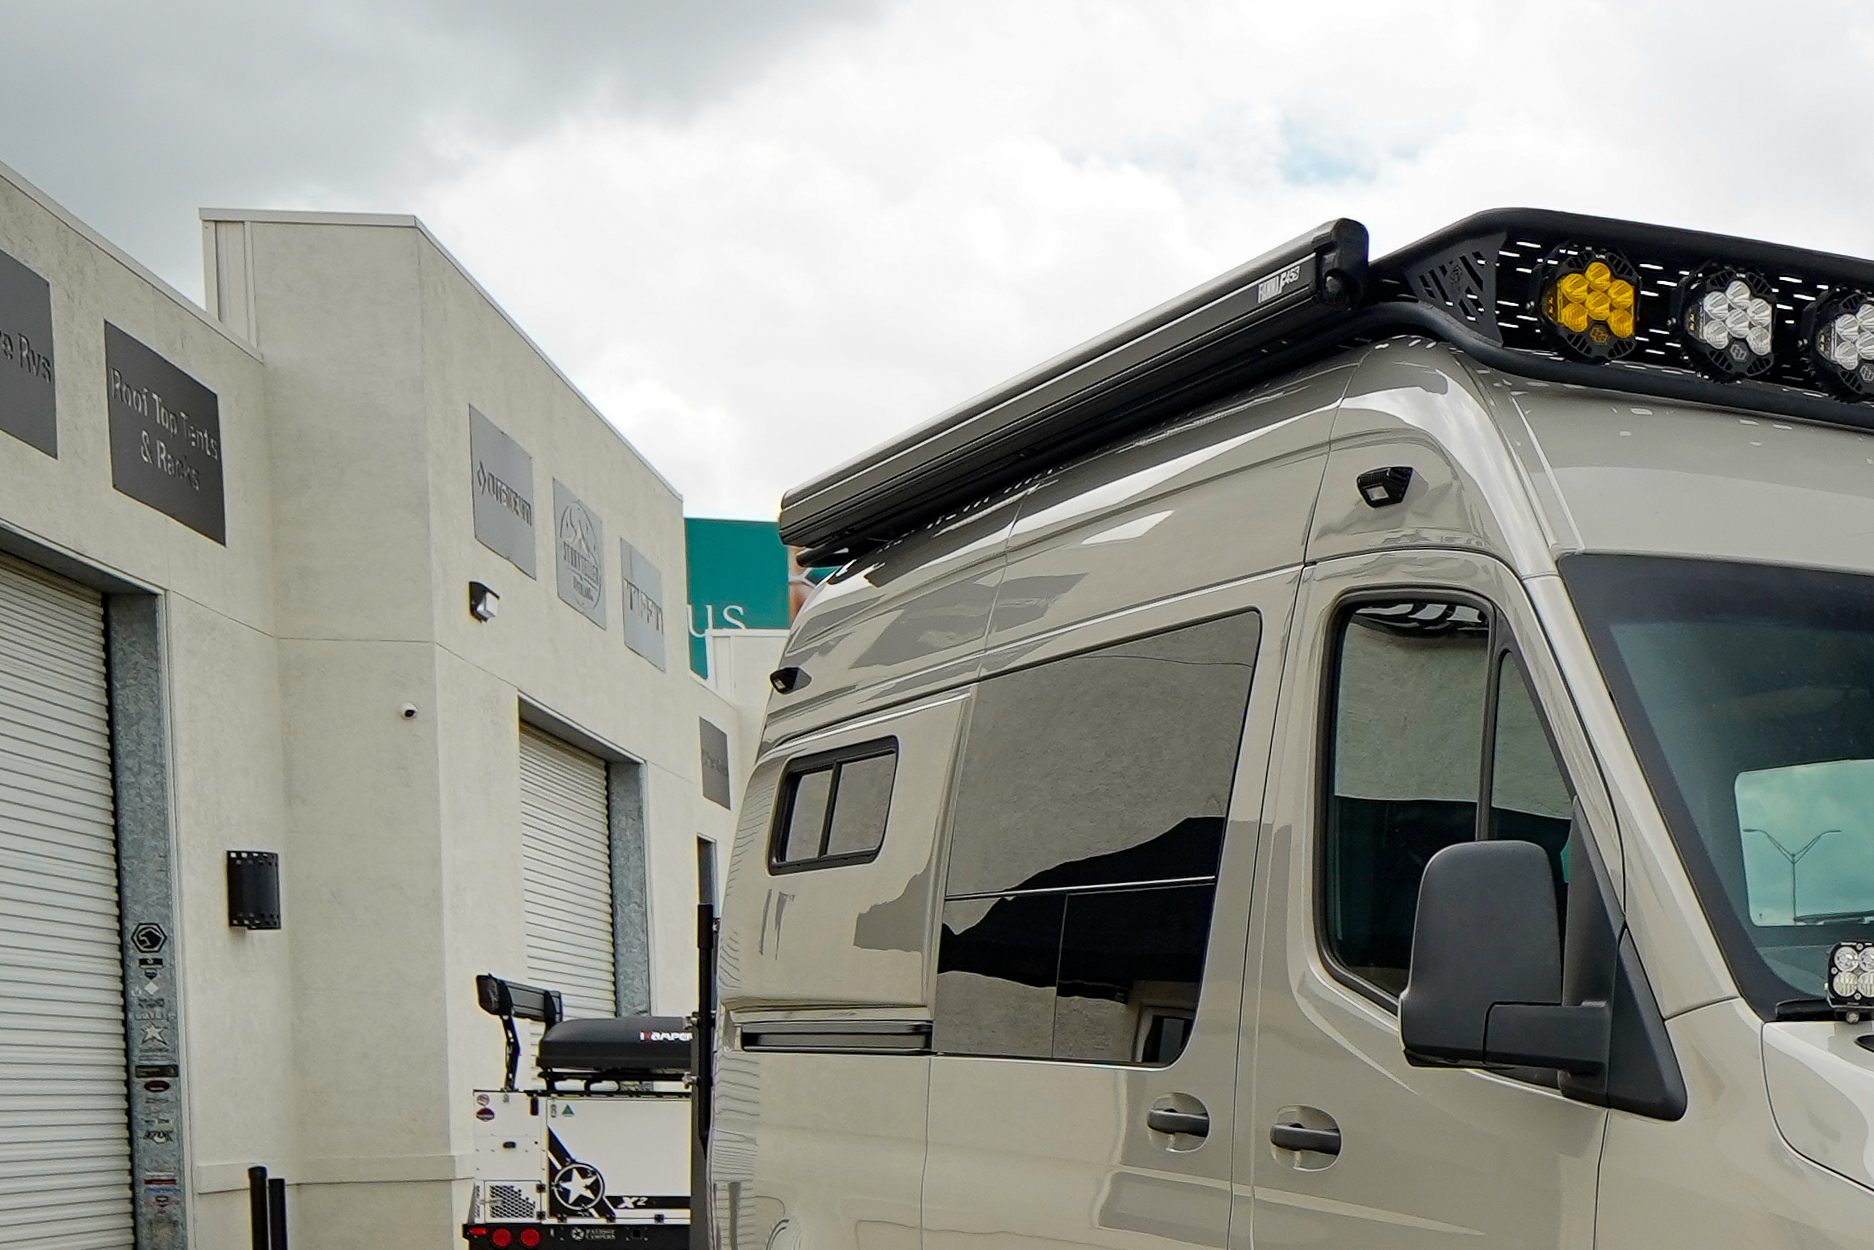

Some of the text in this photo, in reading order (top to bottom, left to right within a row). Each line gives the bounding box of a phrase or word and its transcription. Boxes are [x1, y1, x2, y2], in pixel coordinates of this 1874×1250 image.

[152, 392, 178, 438] Top
[180, 411, 218, 461] Tents
[141, 430, 200, 492] & Racks
